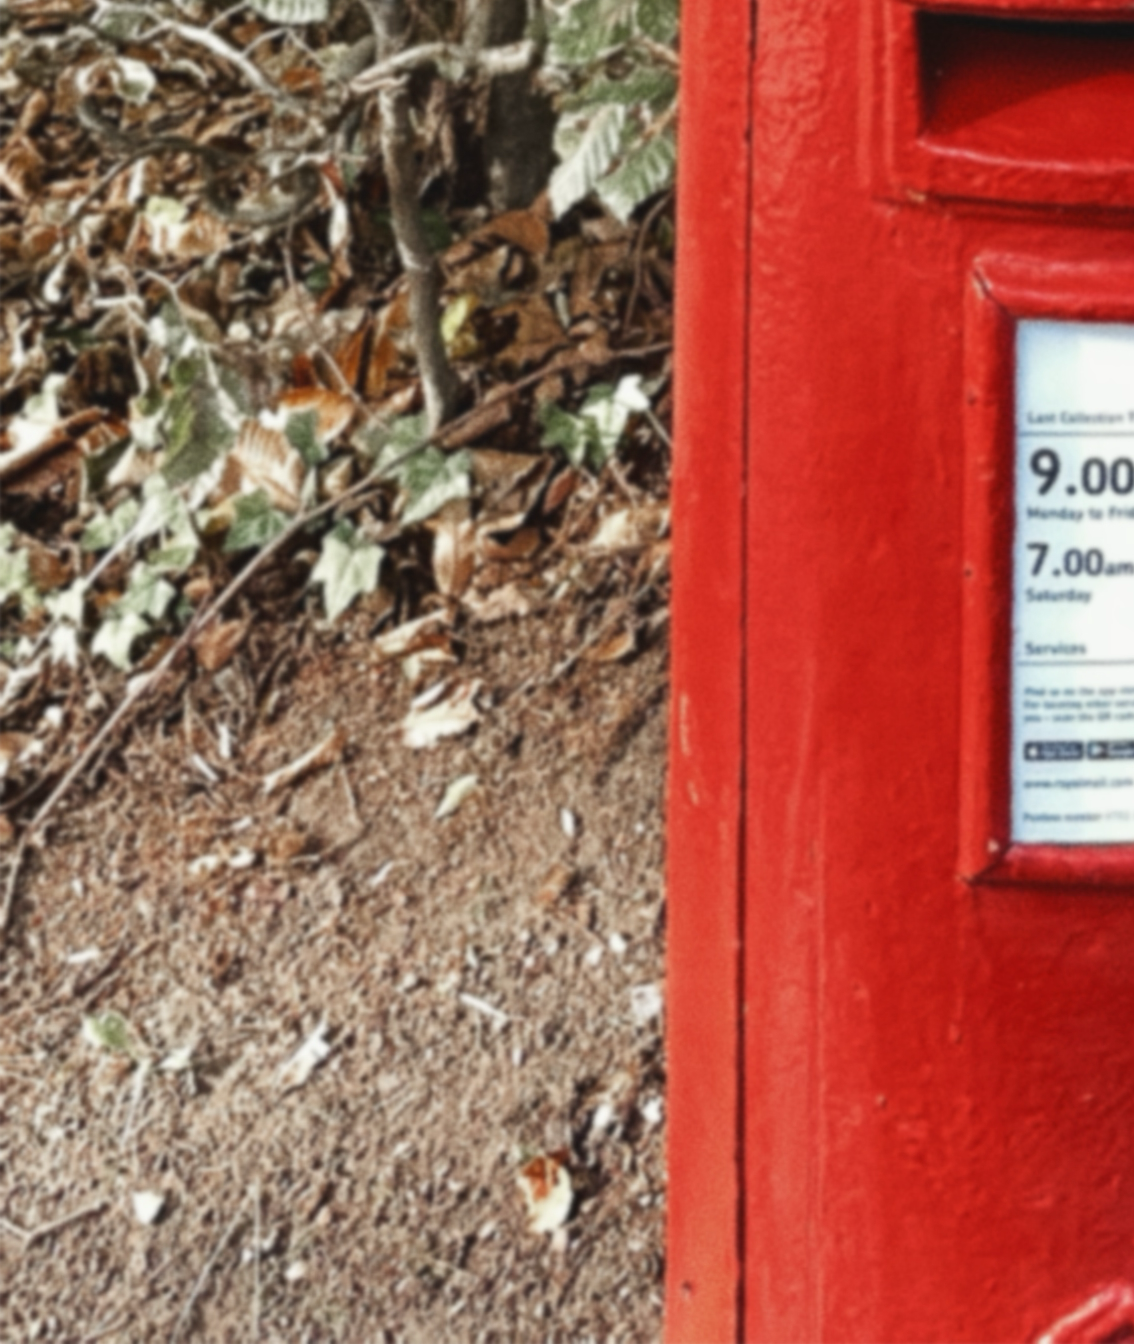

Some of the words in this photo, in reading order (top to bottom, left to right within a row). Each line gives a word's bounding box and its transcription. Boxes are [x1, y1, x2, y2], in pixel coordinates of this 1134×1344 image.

[1027, 410, 1056, 425] Last
[1027, 506, 1083, 522] Monday
[1089, 507, 1103, 520] to
[1027, 542, 1134, 578] 7.00am
[1026, 588, 1092, 604] Saturday
[1025, 641, 1087, 656] Services
